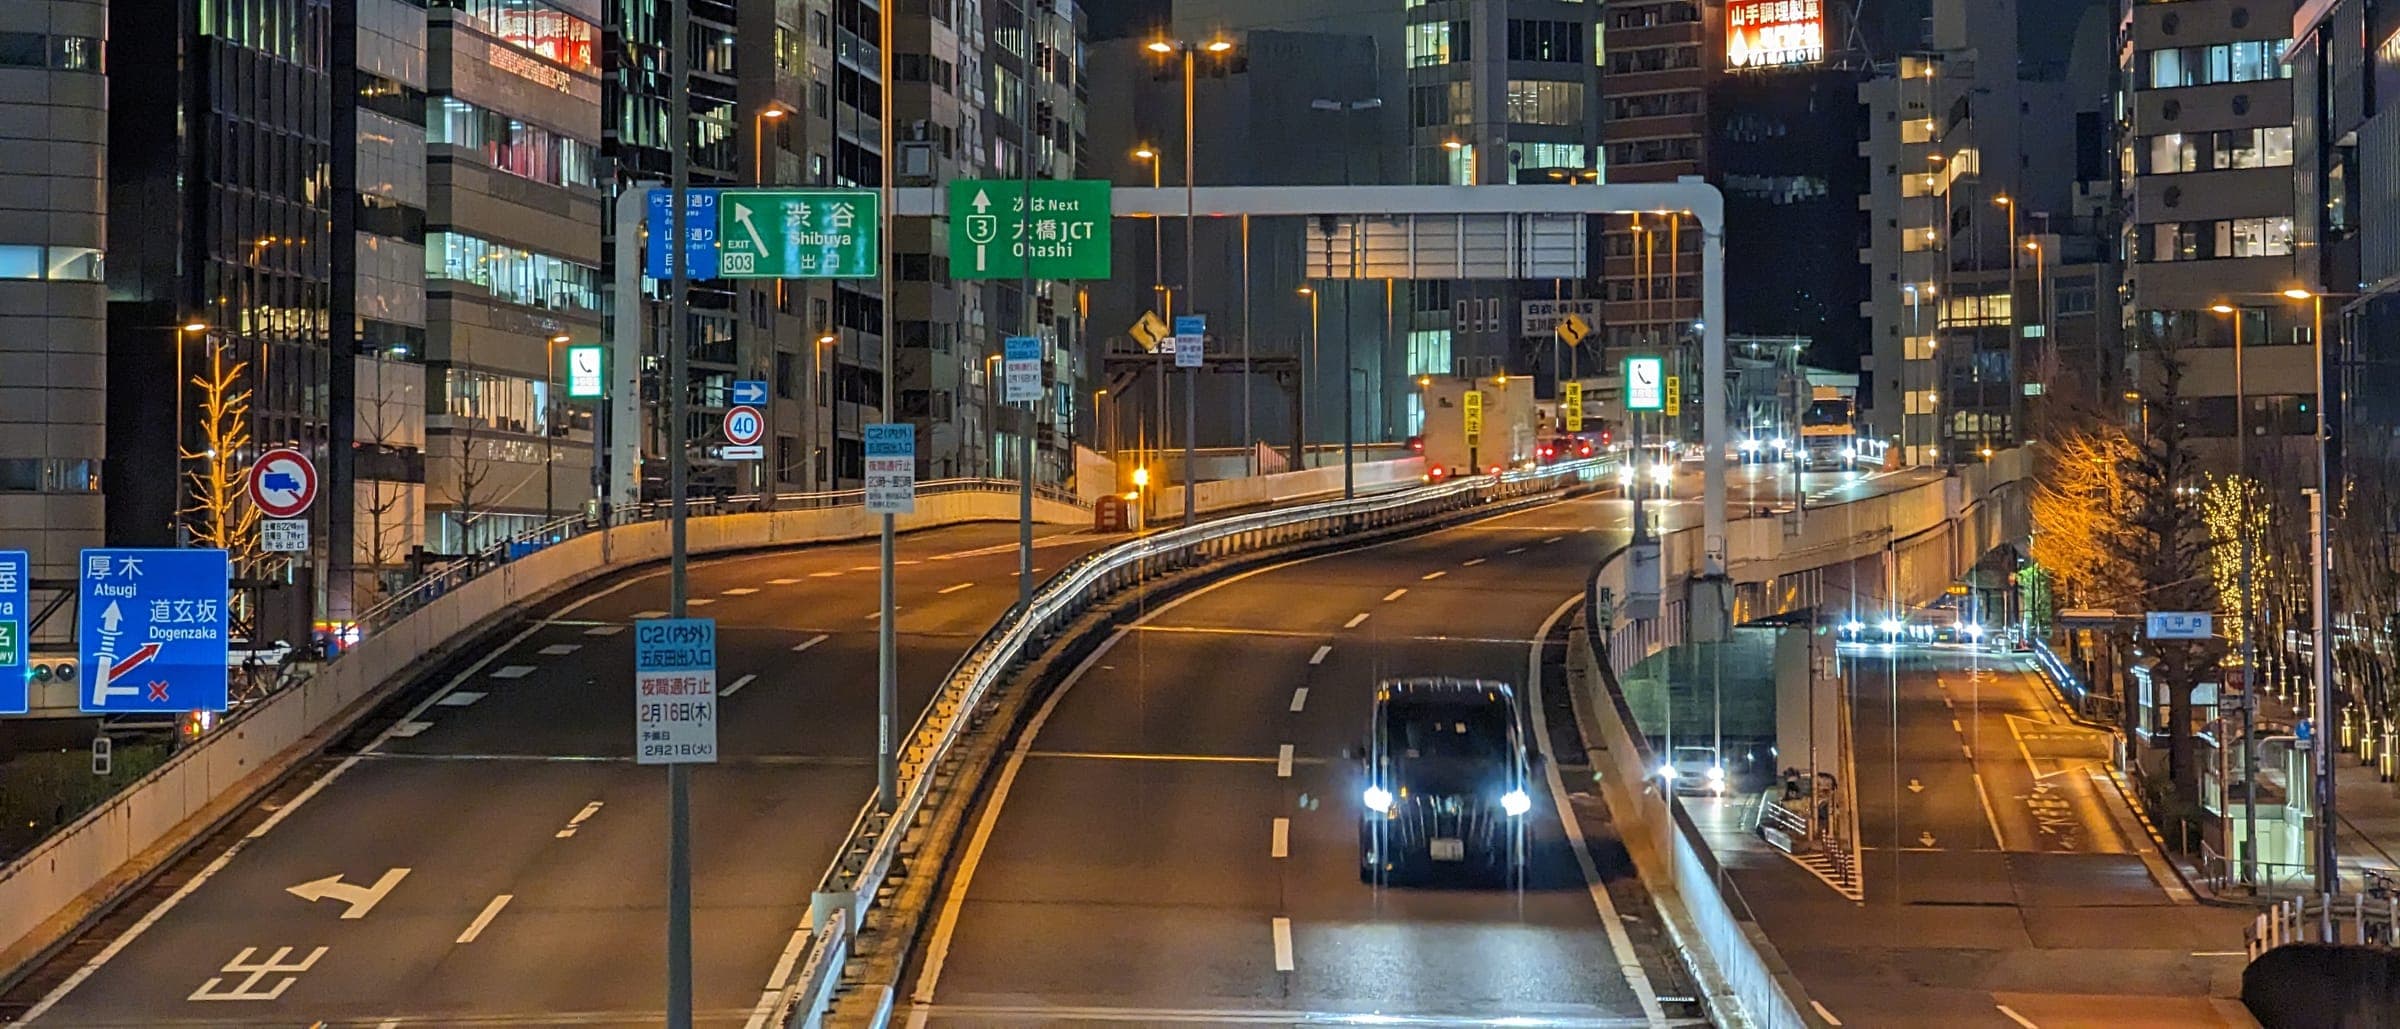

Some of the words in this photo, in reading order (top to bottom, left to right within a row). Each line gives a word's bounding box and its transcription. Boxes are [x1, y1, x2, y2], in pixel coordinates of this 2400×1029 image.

[1049, 199, 1079, 211] Next
[787, 202, 855, 228] 渋谷
[976, 219, 988, 237] 3
[728, 240, 751, 249] EXIT
[791, 232, 851, 247] Shibuya
[1012, 242, 1073, 257] Ohashi
[726, 255, 752, 271] 303
[801, 254, 840, 269] 出口
[733, 416, 754, 434] 40
[87, 556, 144, 580] 厚木
[93, 583, 137, 598] Atsugi
[0, 601, 14, 615] a
[150, 599, 218, 624] 道玄坂
[150, 625, 217, 642] Dogenzaka
[640, 625, 711, 645] C2(内外)
[640, 648, 712, 668] 五反田出入口
[641, 677, 711, 696] 夜間通行止
[641, 702, 712, 723] 2月16日(木)
[644, 743, 713, 757] 2月21日(火)
[187, 946, 330, 1000] 出
